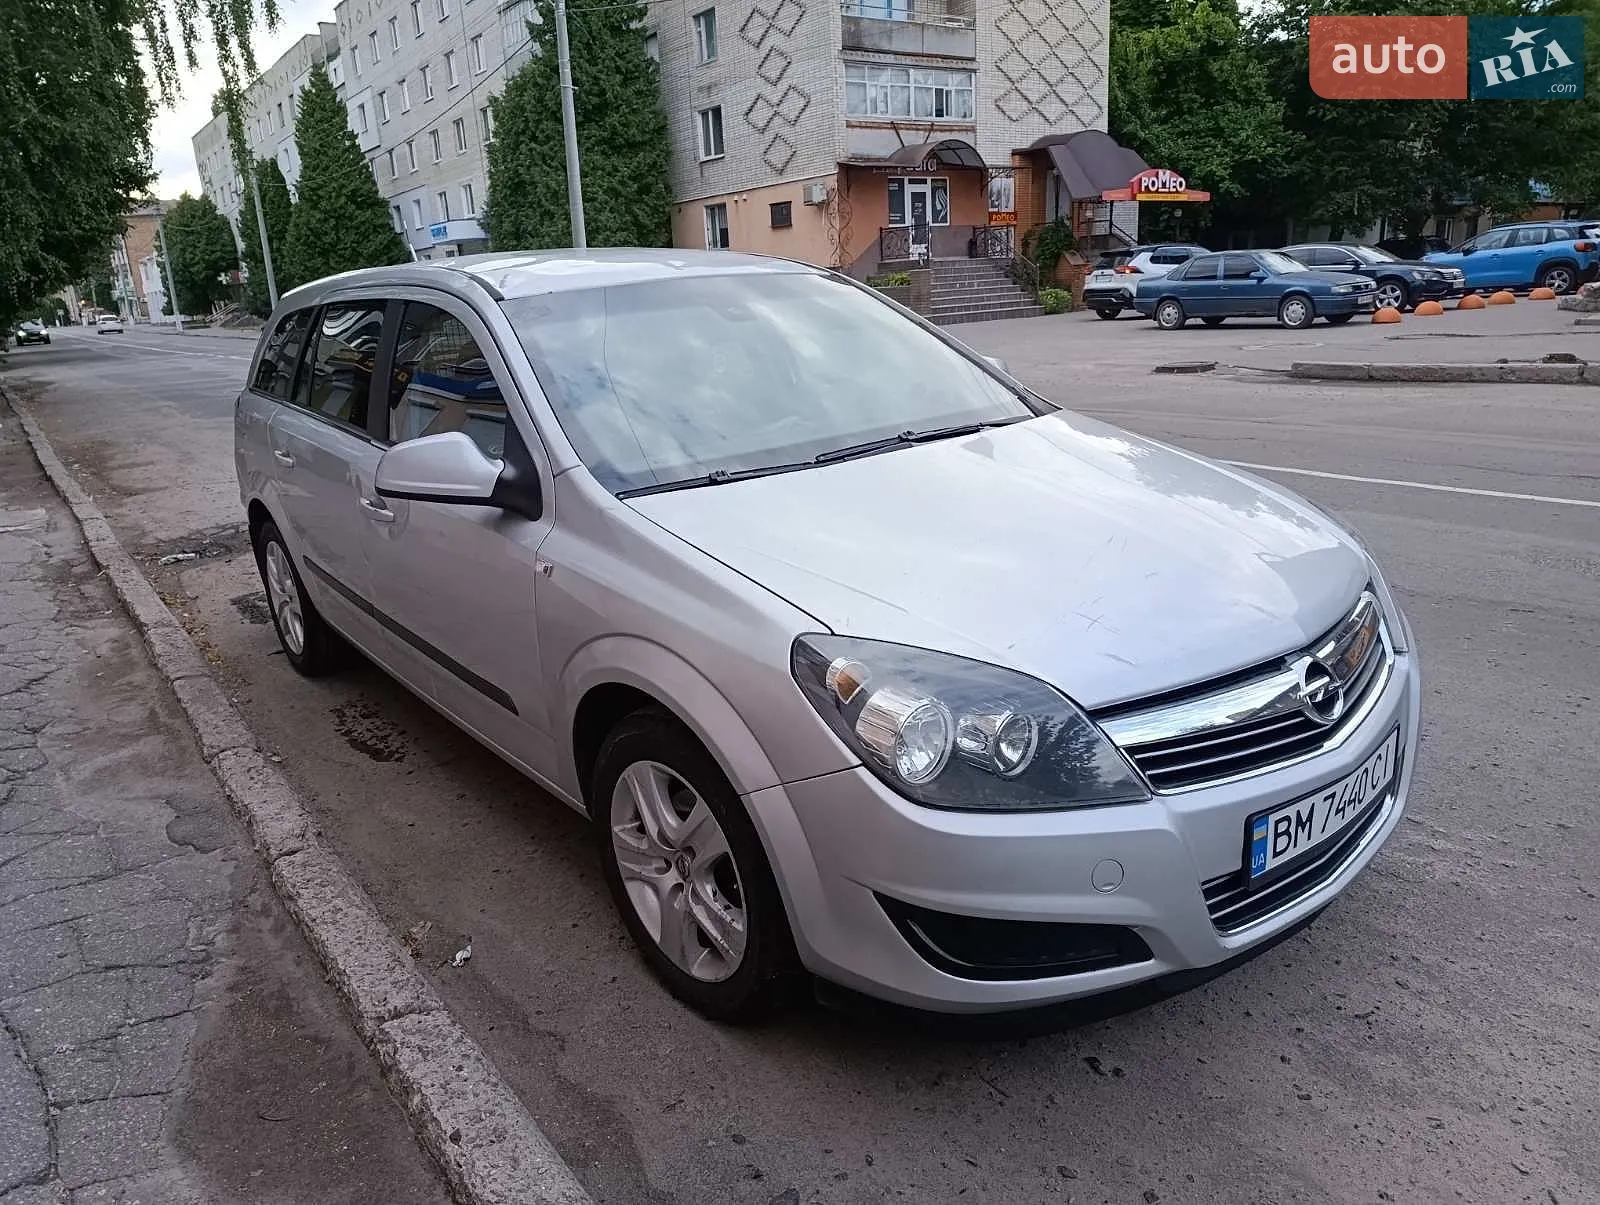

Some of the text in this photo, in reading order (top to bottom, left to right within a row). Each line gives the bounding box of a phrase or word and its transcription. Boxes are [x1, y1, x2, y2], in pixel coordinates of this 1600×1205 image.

[1272, 743, 1390, 859] BM 7440 CI
[1251, 852, 1265, 869] UA
